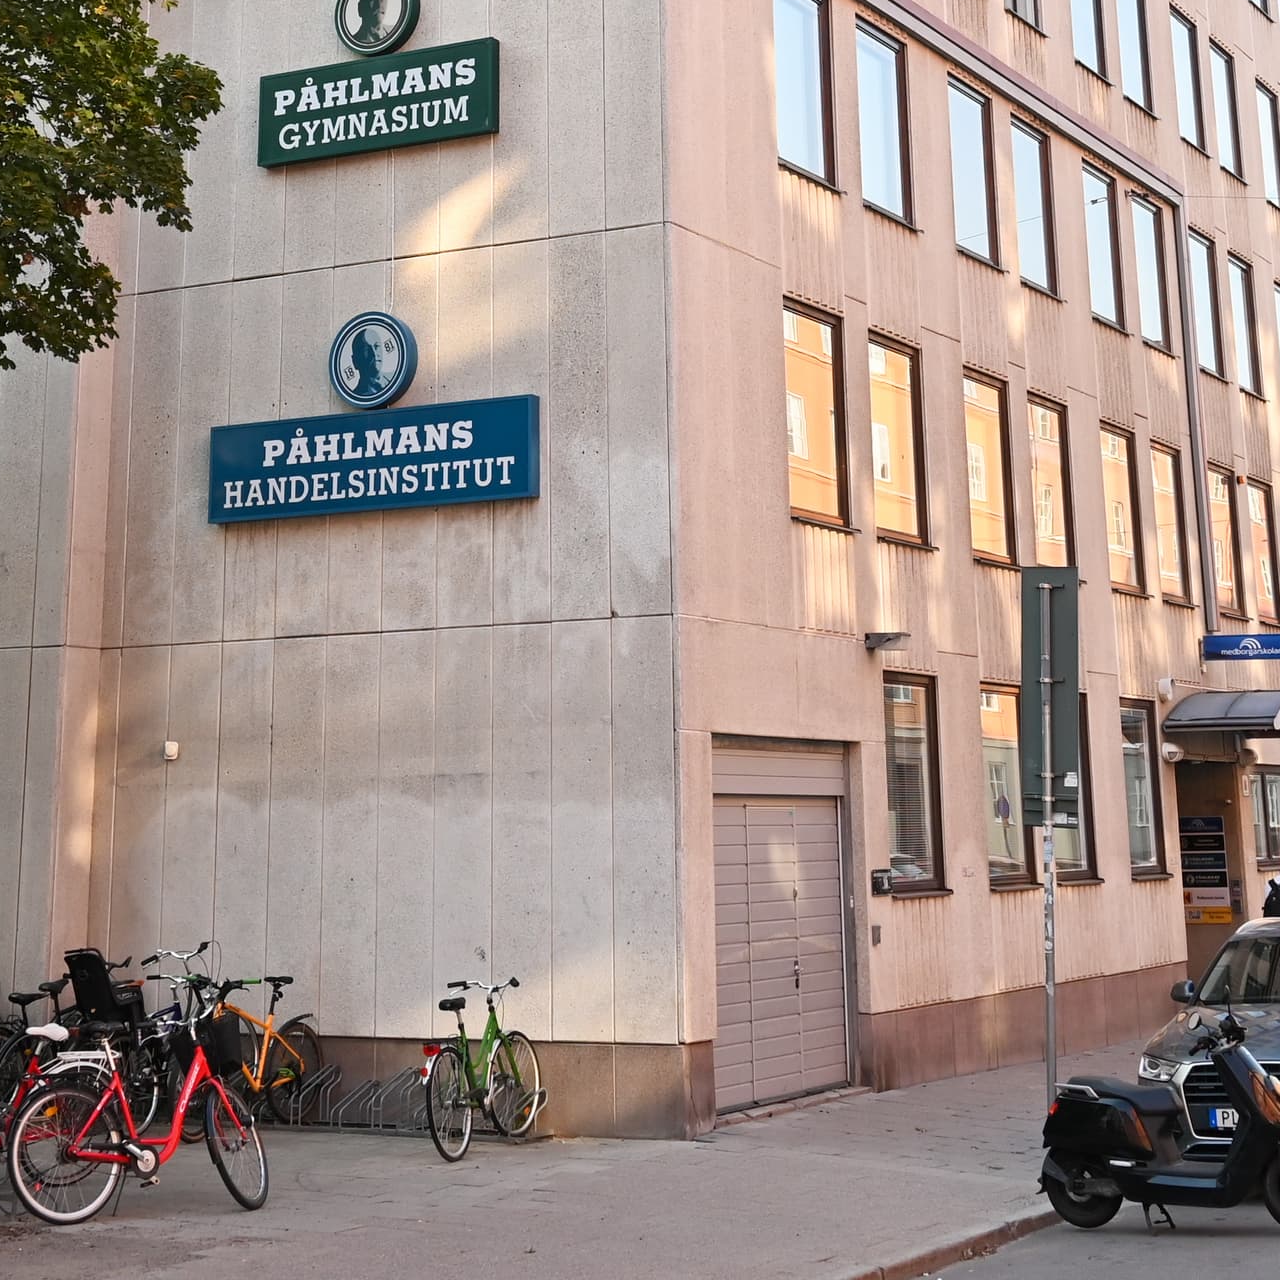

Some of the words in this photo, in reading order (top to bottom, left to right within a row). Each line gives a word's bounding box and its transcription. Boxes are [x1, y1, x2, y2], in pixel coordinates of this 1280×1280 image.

[274, 58, 477, 117] PÅHLMANS
[278, 95, 471, 150] GYMNASIUM
[344, 367, 355, 379] 18
[262, 420, 474, 468] PÅHLMANS
[223, 456, 516, 509] HANDELSINSTITUT
